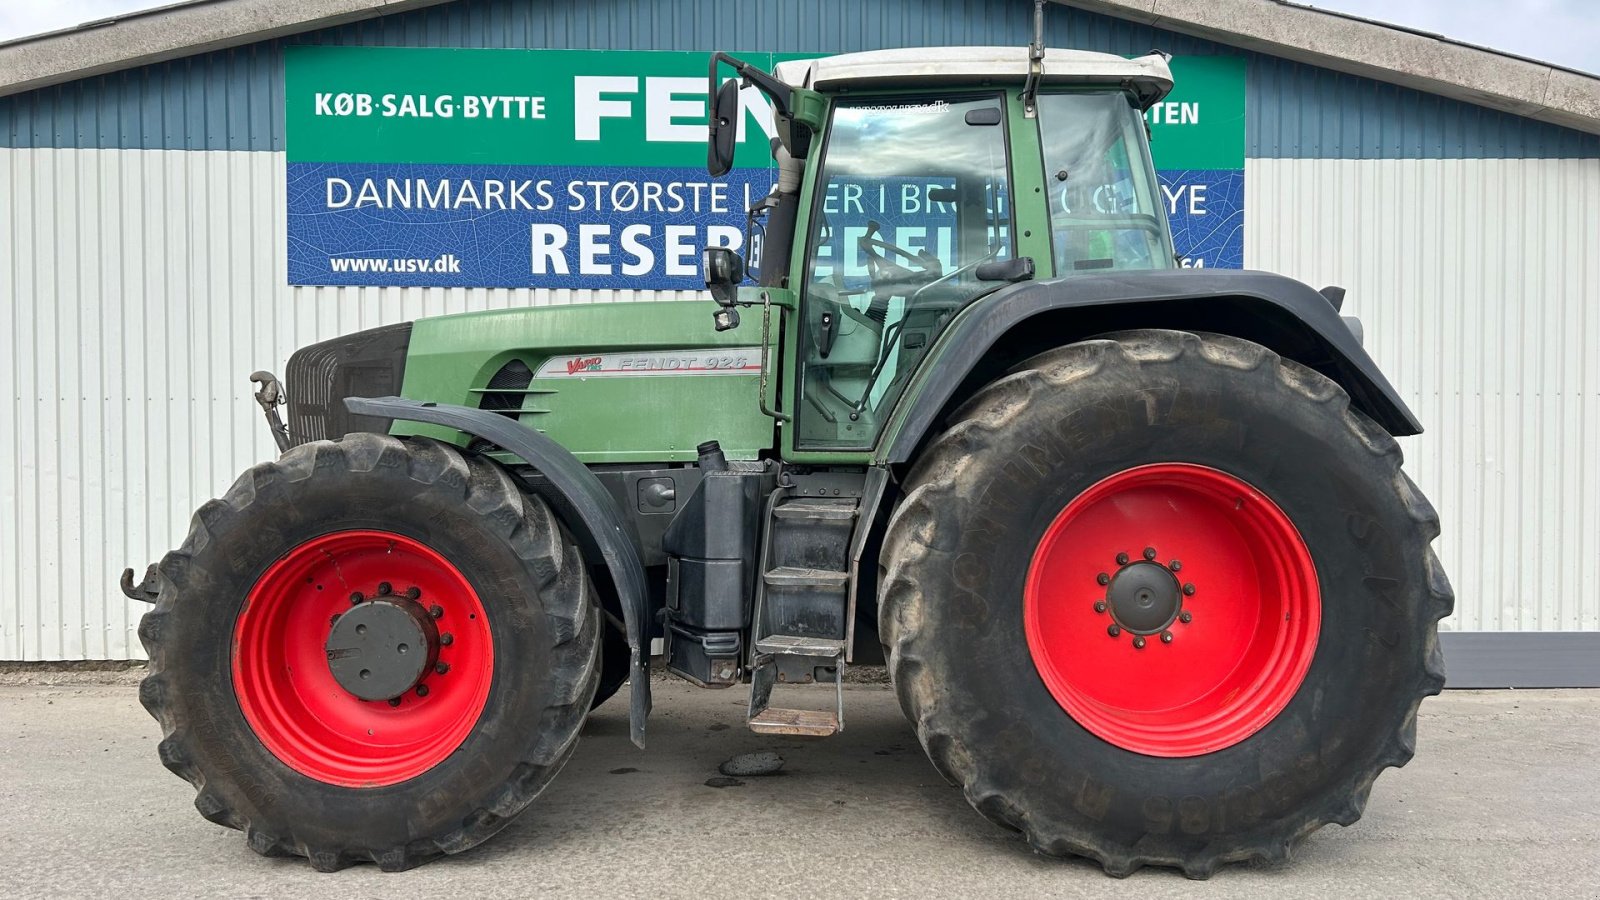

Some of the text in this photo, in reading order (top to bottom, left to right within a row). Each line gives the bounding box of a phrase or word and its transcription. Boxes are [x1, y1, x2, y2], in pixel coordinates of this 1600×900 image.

[326, 177, 554, 211] DANMARKS
[567, 180, 728, 214] STØRSTE
[744, 182, 865, 214] LER
[330, 254, 461, 274] www.usv.dk
[618, 356, 748, 371] FENDT 926
